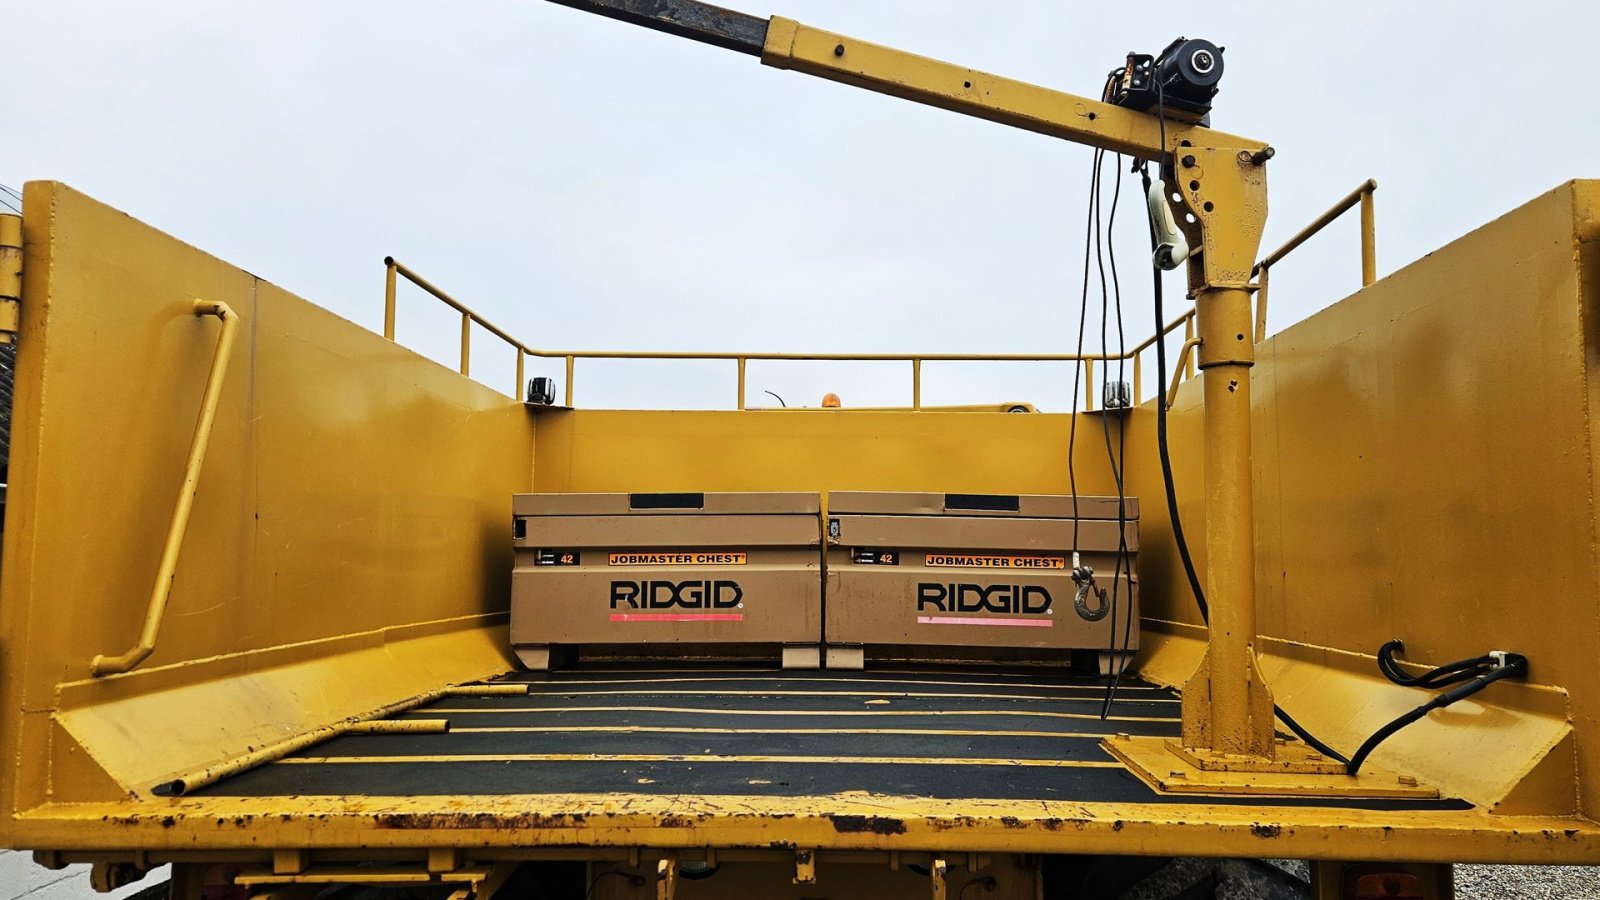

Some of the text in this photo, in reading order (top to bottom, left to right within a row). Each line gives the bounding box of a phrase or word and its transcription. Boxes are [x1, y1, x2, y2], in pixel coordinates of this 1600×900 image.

[560, 554, 574, 564] 42
[611, 554, 693, 564] JOBMASTER
[880, 554, 893, 563] 42
[927, 556, 1010, 567] JOBMASTER
[611, 580, 743, 609] RIDGID
[918, 582, 1053, 614] RIDGID
